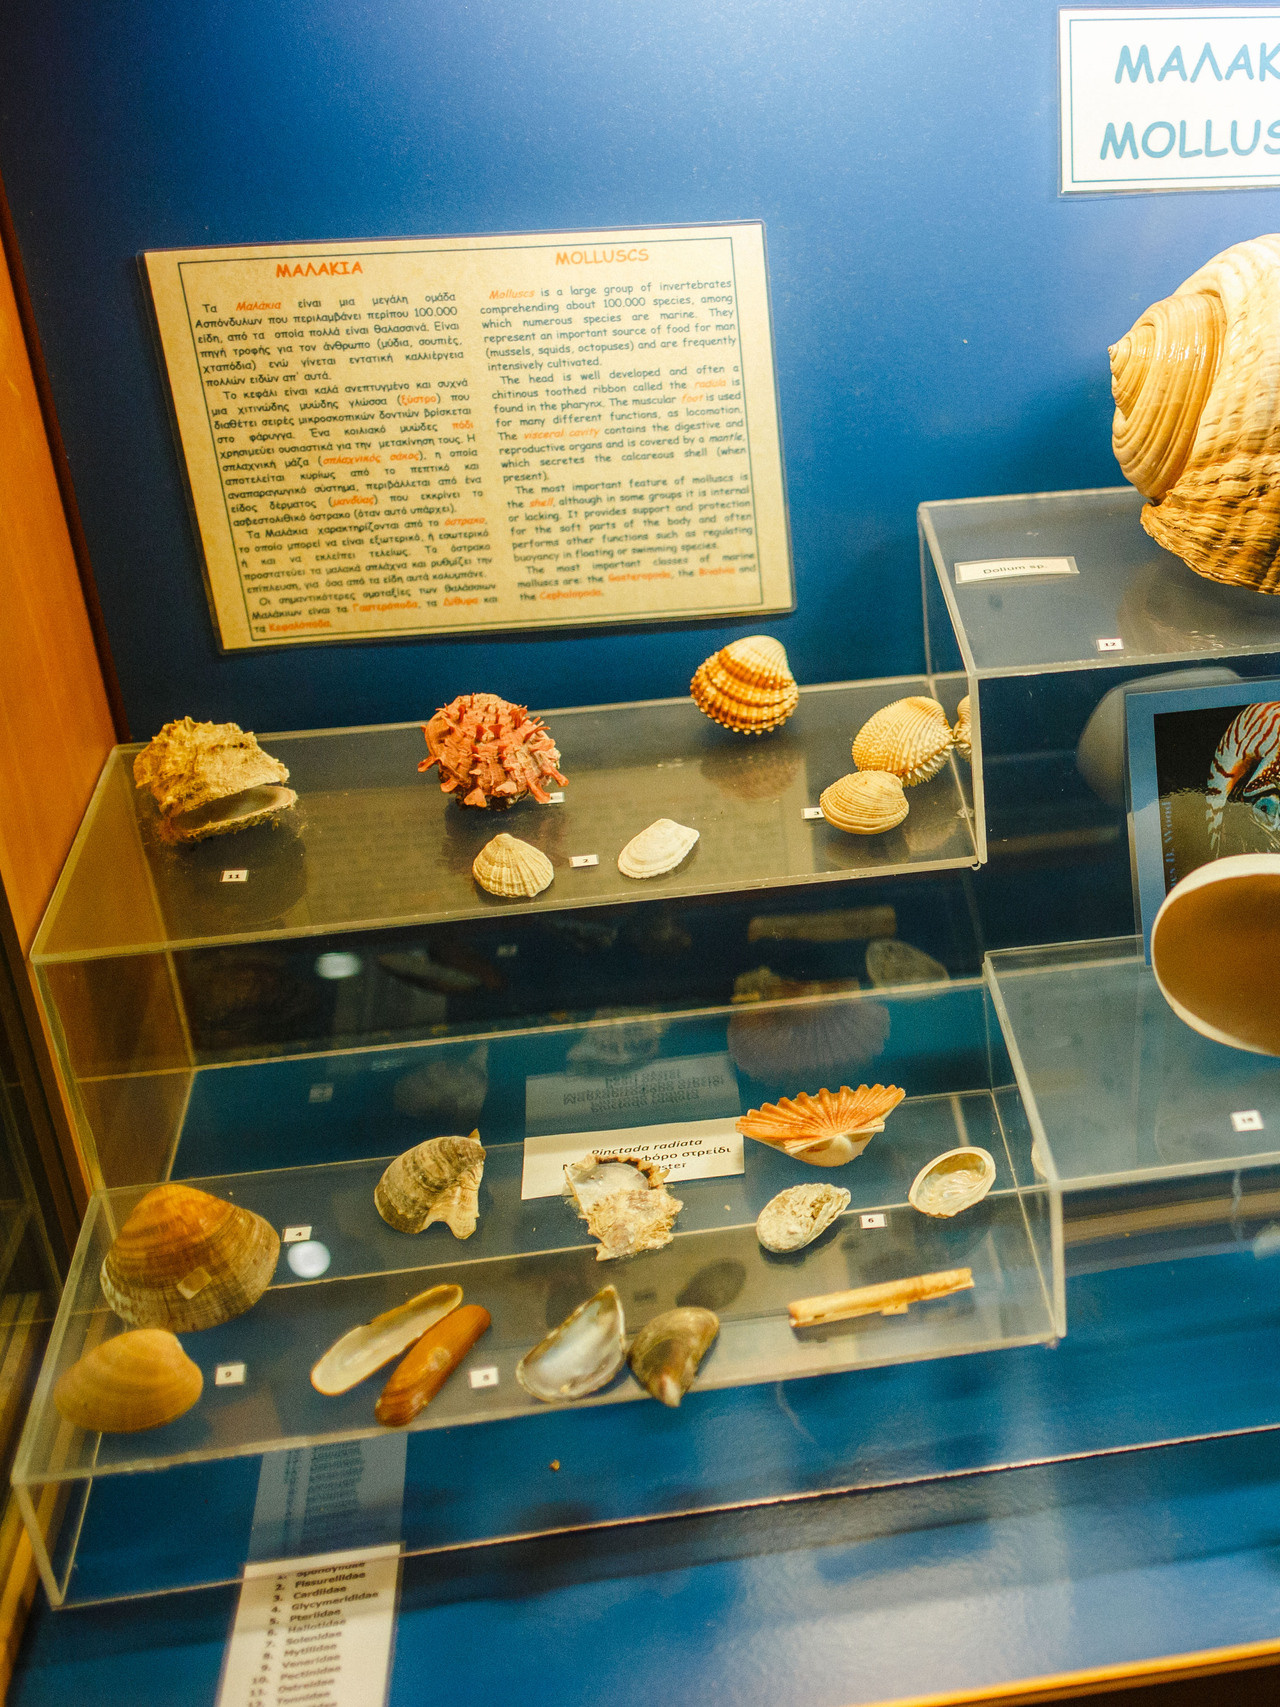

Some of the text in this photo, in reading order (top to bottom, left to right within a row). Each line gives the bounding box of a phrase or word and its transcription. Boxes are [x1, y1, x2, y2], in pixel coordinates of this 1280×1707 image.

[555, 248, 649, 265] MOLLUSCS
[276, 261, 363, 278] ΜΑΛΑΚΙΑ
[488, 289, 535, 299] Molluscs
[571, 286, 596, 297] large
[604, 286, 633, 296] group
[641, 282, 651, 291] of
[660, 280, 731, 290] invertebrates
[202, 304, 217, 312] Τα
[298, 299, 321, 308] είναι
[339, 299, 354, 307] μια
[372, 294, 408, 305] μεγάλη
[426, 292, 455, 303] ομάδα
[480, 295, 732, 315] comprehending about 100.000 species, among
[482, 318, 512, 328] which
[523, 318, 574, 326] numerous
[584, 314, 622, 325] species
[709, 307, 733, 318] They
[198, 333, 222, 343] είδη,
[227, 331, 247, 341] από
[275, 329, 303, 338] οποία
[309, 327, 339, 336] πολλά
[346, 326, 368, 335] είναι
[434, 321, 458, 330] Είναι
[483, 333, 536, 344] represent
[557, 329, 607, 341] important
[651, 325, 662, 334] of
[667, 324, 689, 333] food
[695, 322, 710, 331] for
[486, 346, 533, 359] (mussels,
[538, 344, 573, 356] squids,
[578, 340, 634, 353] octopuses)
[638, 340, 656, 348] and
[683, 336, 735, 348] frequently
[487, 356, 601, 371] intensively cultivated.
[501, 376, 519, 384] The
[529, 374, 554, 383] head
[581, 371, 600, 379] well
[610, 368, 660, 379] developed
[670, 366, 687, 375] and
[696, 365, 724, 373] often
[491, 389, 538, 399] chitinous
[545, 386, 586, 395] toothed
[593, 384, 626, 393] ribbon
[633, 381, 664, 391] called
[494, 404, 523, 413] found
[540, 401, 557, 410] the
[561, 400, 605, 412] pharynx.
[611, 398, 628, 406] The
[632, 395, 676, 405] muscular
[718, 391, 741, 400] used
[496, 418, 512, 427] for
[519, 419, 545, 427] many
[553, 414, 602, 424] different
[610, 411, 660, 421] functions,
[686, 407, 740, 416] locomotion.
[499, 432, 517, 440] The
[605, 426, 645, 434] contains
[652, 423, 668, 431] the
[675, 421, 720, 432] digestive
[727, 418, 743, 427] and
[983, 566, 1026, 574] Dolium
[653, 1139, 703, 1150] radiata
[682, 1146, 731, 1158] στρείδι
